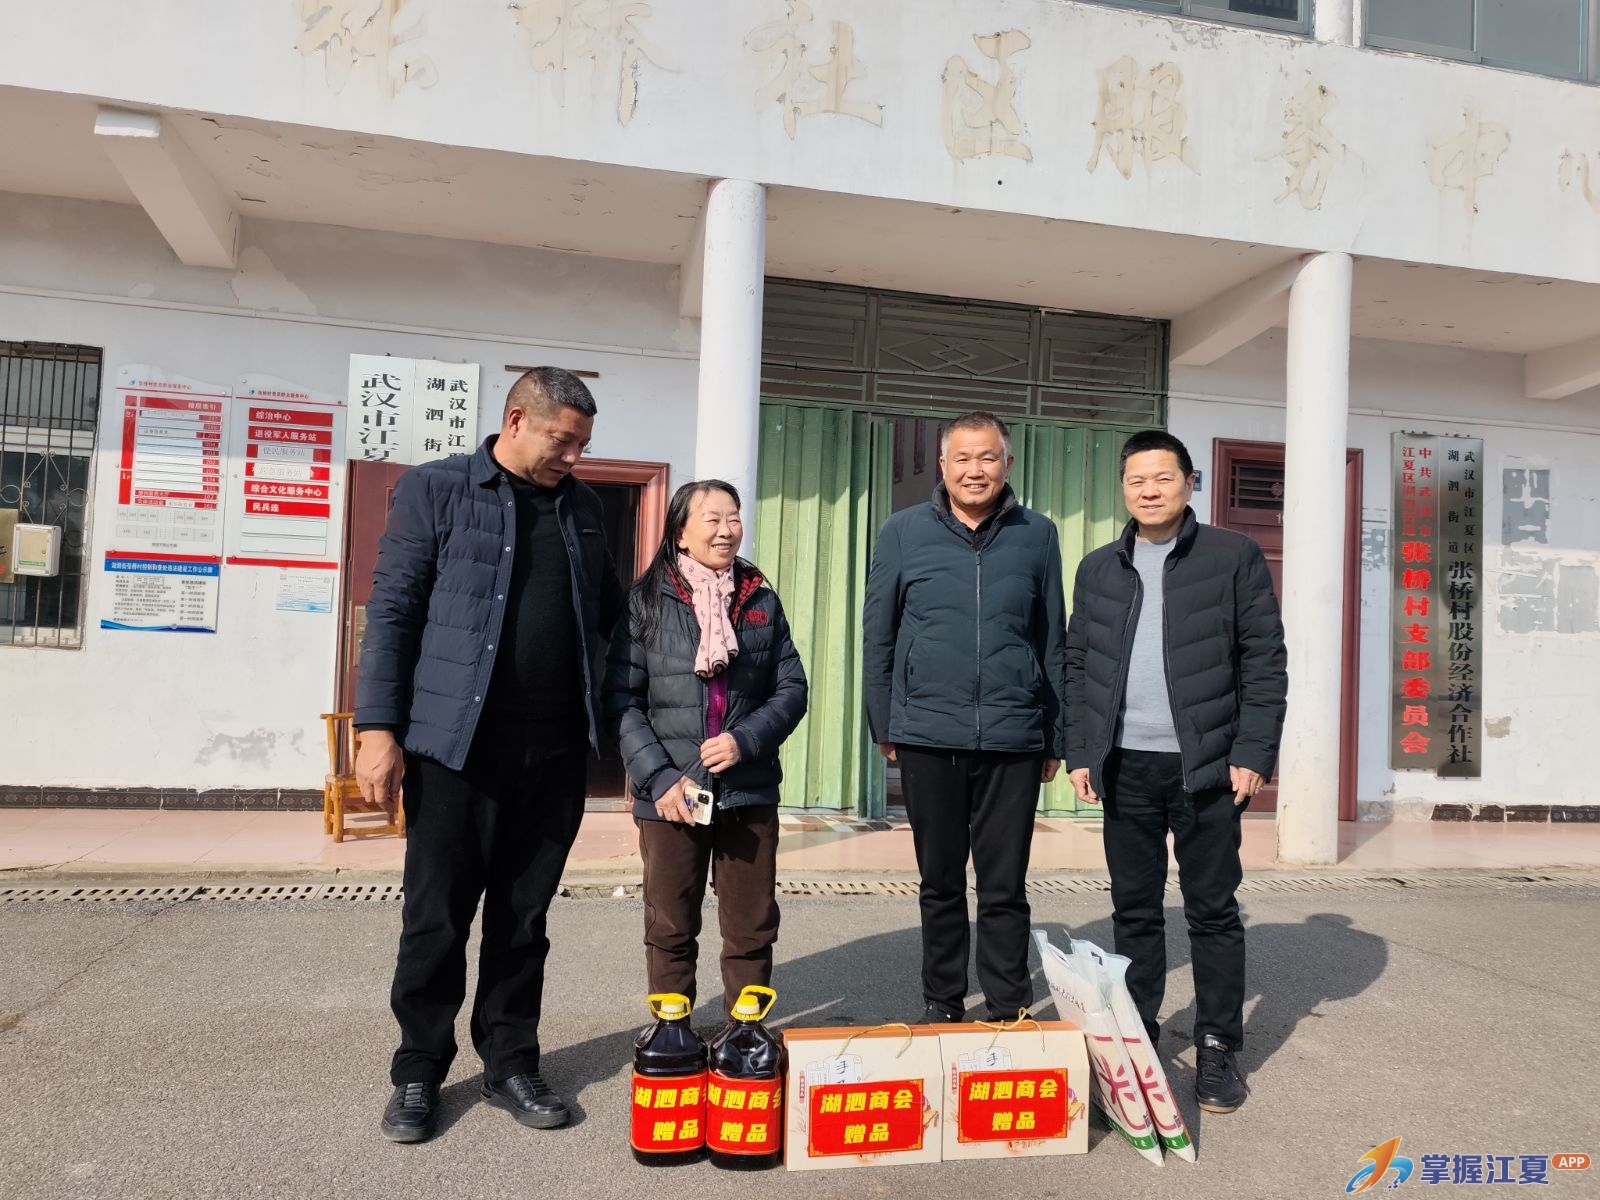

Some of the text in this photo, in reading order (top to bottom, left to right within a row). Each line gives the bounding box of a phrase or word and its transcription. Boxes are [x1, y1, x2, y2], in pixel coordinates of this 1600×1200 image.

[255, 410, 292, 422] 综治中心
[254, 429, 317, 442] 退役军人服务站
[250, 484, 323, 497] 综合文化服务中心
[1447, 449, 1459, 553] 湖泗街道
[252, 502, 280, 512] 民兵连
[1464, 450, 1475, 554] 武汉市江夏区
[1400, 541, 1431, 753] 张桥村支部委员会
[1447, 561, 1474, 764] 张桥村股份经济合作社
[820, 1089, 914, 1114] 湖泗商会
[969, 1079, 1059, 1102] 湖泗商会
[652, 1119, 699, 1142] 赠品
[720, 1121, 767, 1143] 赠品
[992, 1111, 1036, 1132] 赠品
[844, 1123, 890, 1145] 赠品
